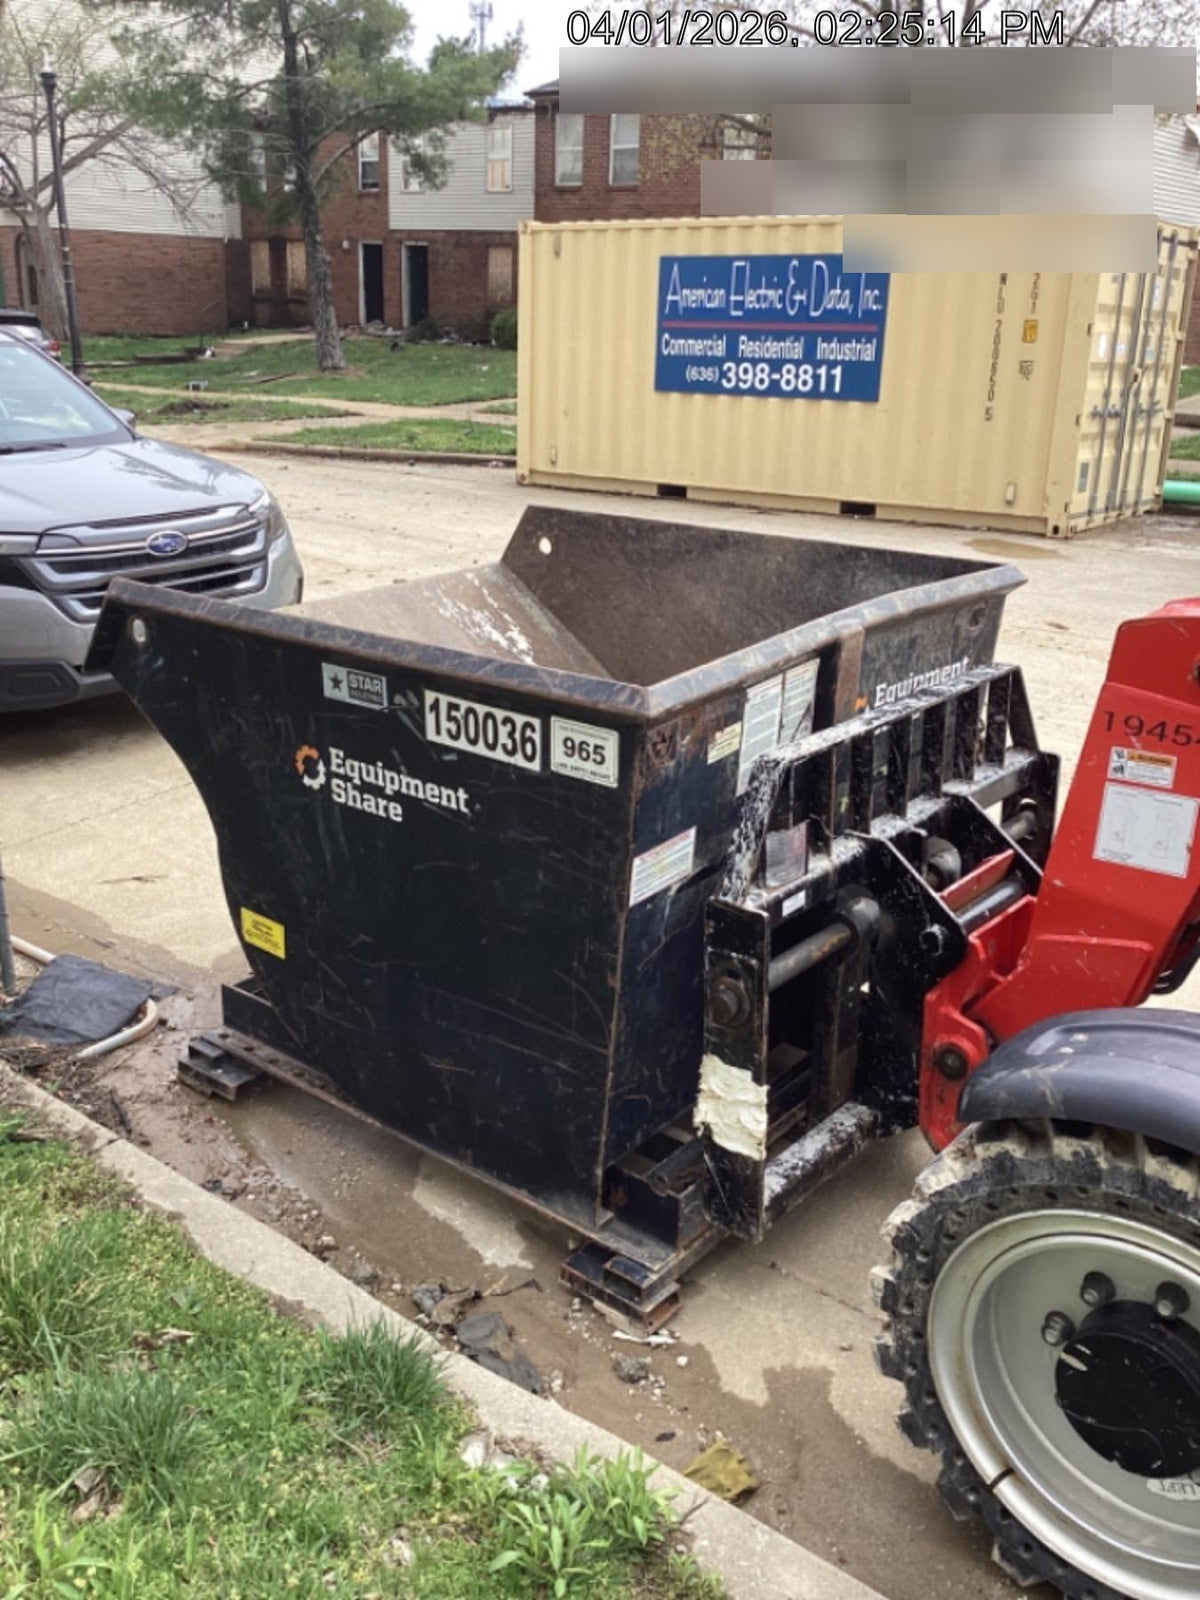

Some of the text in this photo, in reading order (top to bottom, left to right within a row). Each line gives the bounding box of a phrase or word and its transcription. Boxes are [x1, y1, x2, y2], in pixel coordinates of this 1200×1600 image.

[665, 259, 883, 318] American Electric & Data, Inc.
[662, 332, 877, 362] Commercial Residential Industrial
[685, 361, 842, 394] (636) 398-8811
[348, 673, 382, 695] STAR
[874, 656, 970, 708] Equipment
[429, 696, 537, 764] 150036
[1104, 710, 1200, 746] 1945
[563, 736, 606, 766] 965
[329, 746, 470, 814] Equipment
[330, 778, 403, 822] Share
